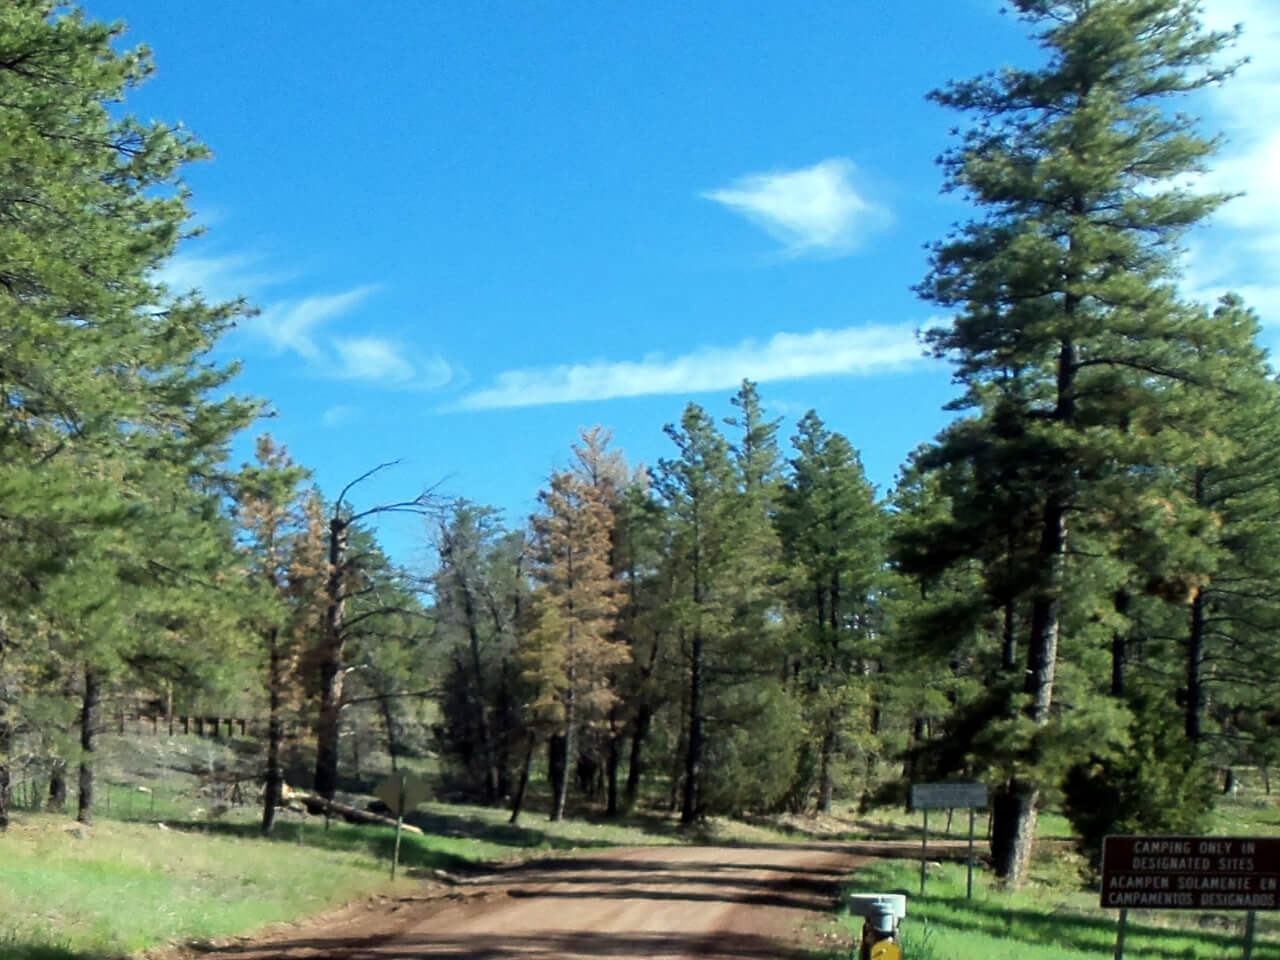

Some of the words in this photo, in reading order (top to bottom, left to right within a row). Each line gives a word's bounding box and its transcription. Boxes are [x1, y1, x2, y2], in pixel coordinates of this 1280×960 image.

[1134, 841, 1192, 854] CAMPING
[1199, 842, 1232, 854] ONLY
[1241, 842, 1255, 854] IN
[1132, 857, 1210, 870] DESIGNATED
[1218, 858, 1255, 870] SITES
[1109, 876, 1169, 889] ACAMPEN
[1178, 877, 1251, 890] SOLAMENTE
[1260, 878, 1277, 890] EN
[1108, 892, 1193, 905] CAMPAMENTOS
[1200, 893, 1275, 906] DESIGNADOS
